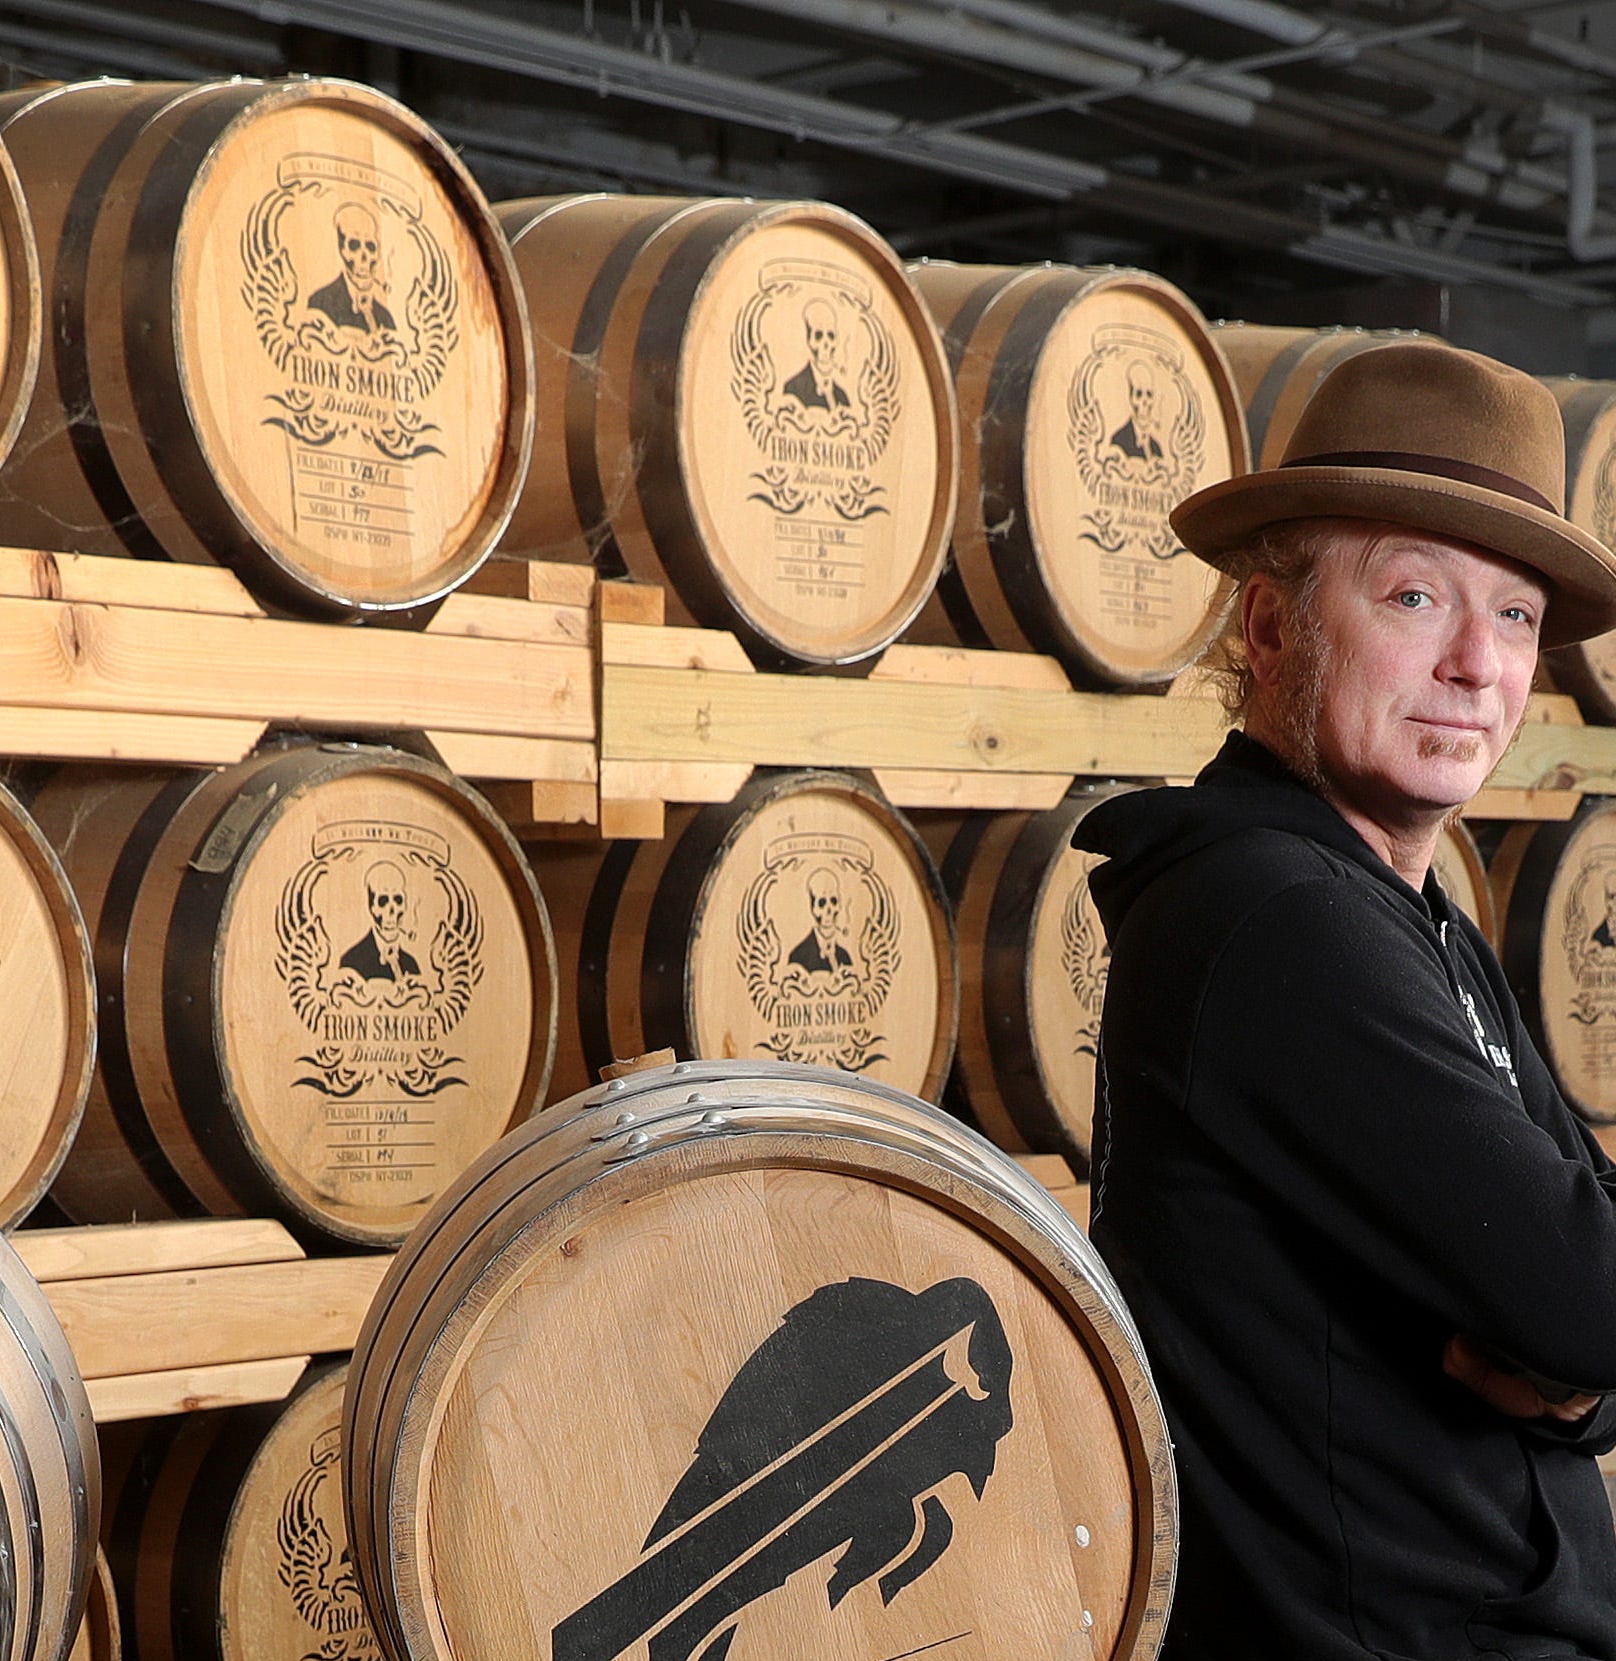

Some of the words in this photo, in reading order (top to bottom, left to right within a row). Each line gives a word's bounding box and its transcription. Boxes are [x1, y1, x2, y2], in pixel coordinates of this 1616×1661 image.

[292, 355, 339, 389] IRON
[346, 365, 414, 403] SMOKE
[320, 393, 388, 424] Distillery
[771, 436, 808, 464] IRON
[812, 442, 865, 471] SMOKE
[324, 1014, 367, 1041] IRON
[373, 1014, 437, 1041] SMOKE
[776, 1003, 812, 1028] IRON
[815, 1000, 866, 1026] SMOKE
[351, 1043, 411, 1067] Distillery
